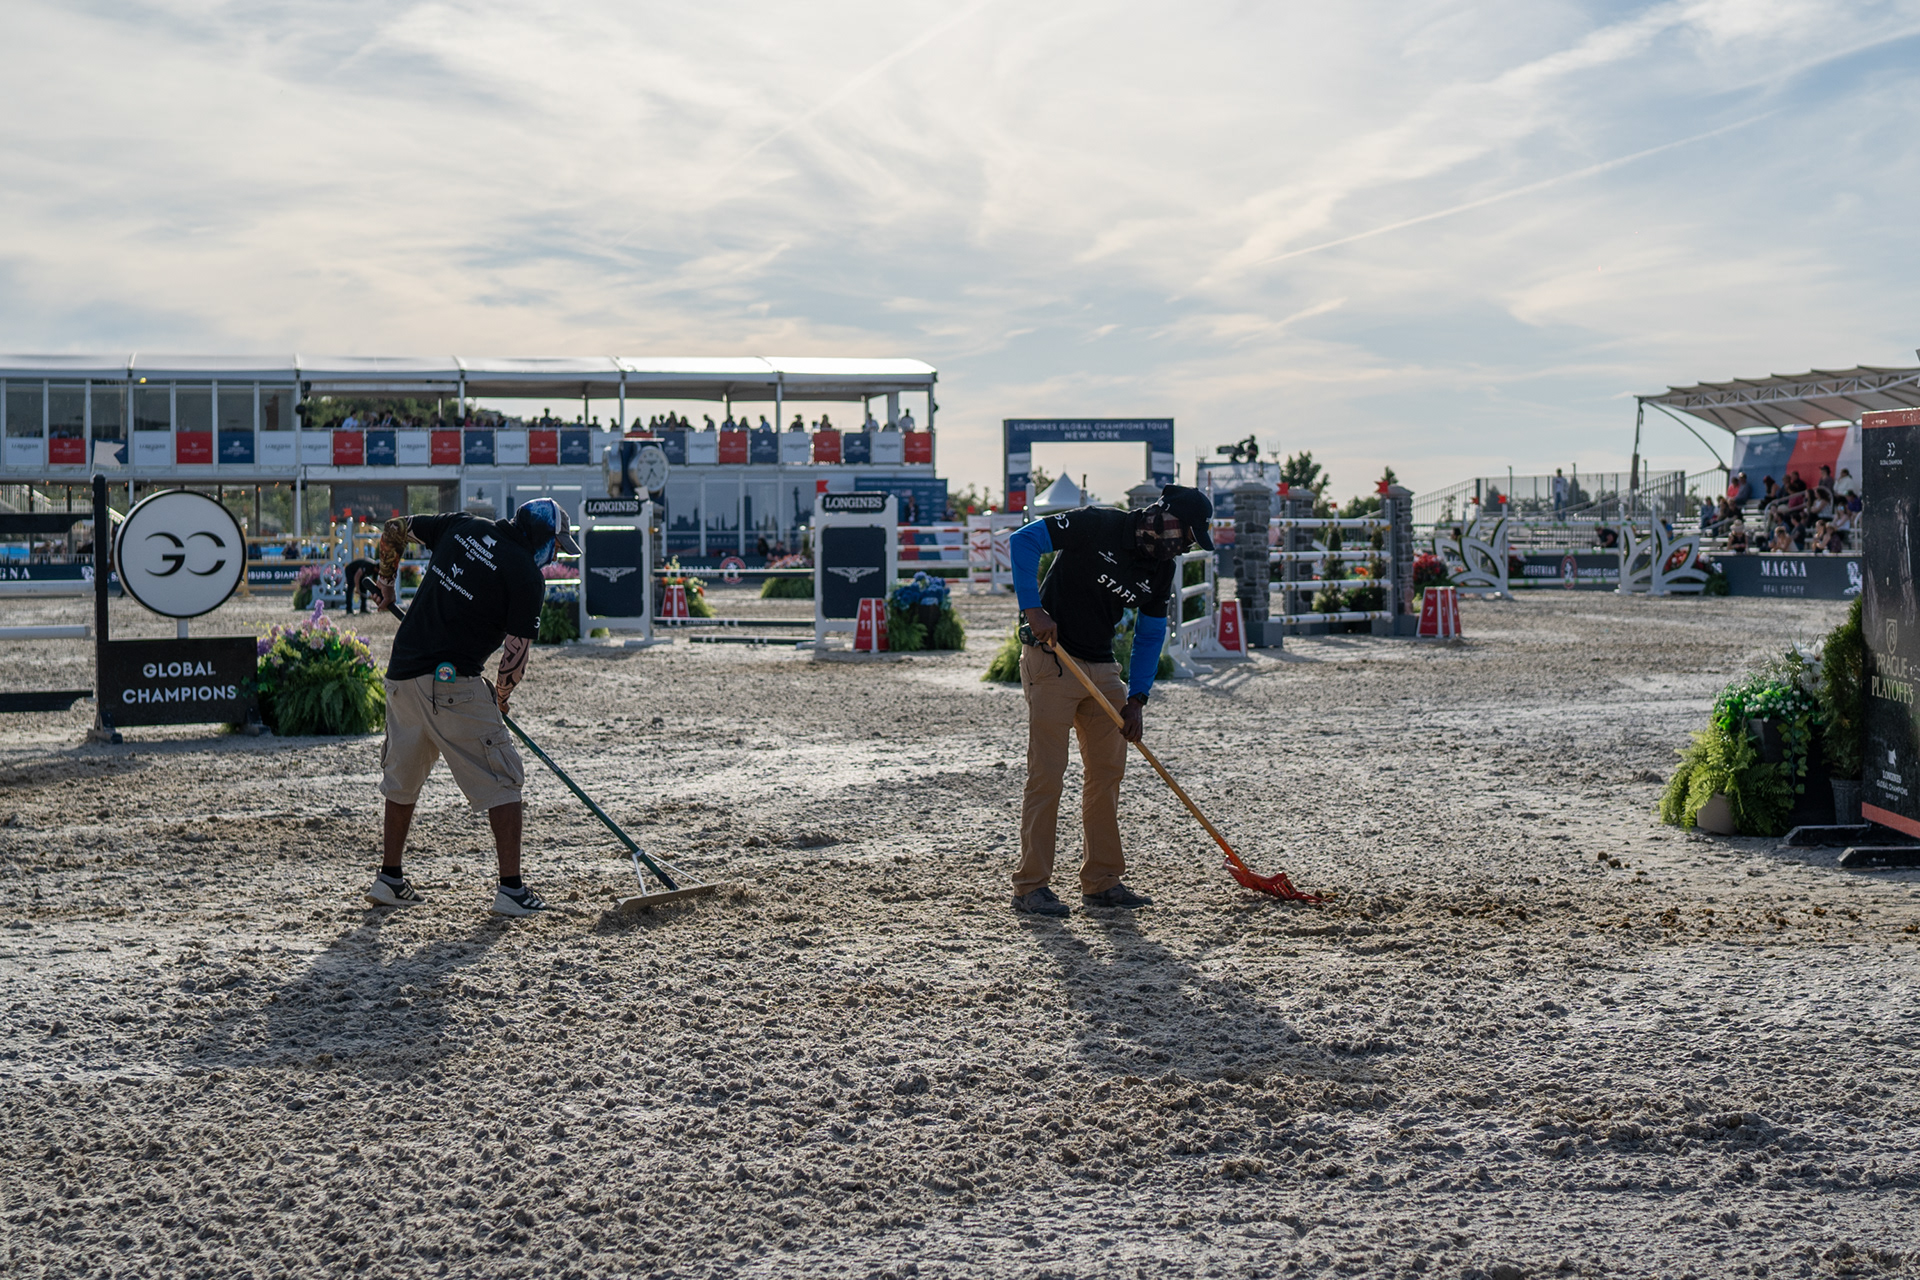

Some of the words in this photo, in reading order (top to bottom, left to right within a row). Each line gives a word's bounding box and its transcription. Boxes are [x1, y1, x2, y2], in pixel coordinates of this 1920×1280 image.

[1014, 423, 1057, 431] LONGINES
[1059, 423, 1093, 431] GLOBAL
[1094, 422, 1145, 430] CHAMPIONS
[1147, 422, 1169, 430] TOUR
[1064, 431, 1088, 440] NEW
[1091, 431, 1120, 440] YORK
[587, 501, 639, 513] LONGINES
[825, 497, 883, 509] LONGINES
[453, 533, 471, 551] GLOBAL
[469, 548, 498, 572] CHAMPIONS
[466, 535, 494, 560] LONGINES
[248, 570, 273, 580] BURG
[1760, 560, 1807, 577] MAGNA
[1097, 573, 1137, 604] STAFF
[1763, 584, 1779, 594] REAL
[1781, 585, 1805, 595] ESTATE
[1426, 606, 1434, 617] 7
[860, 620, 871, 630] 11
[1224, 621, 1234, 634] 3
[143, 661, 217, 679] GLOBAL
[1876, 652, 1908, 679] PRAGUE
[122, 684, 238, 704] CHAMPIONS
[1871, 675, 1914, 705] PLAYOFFS
